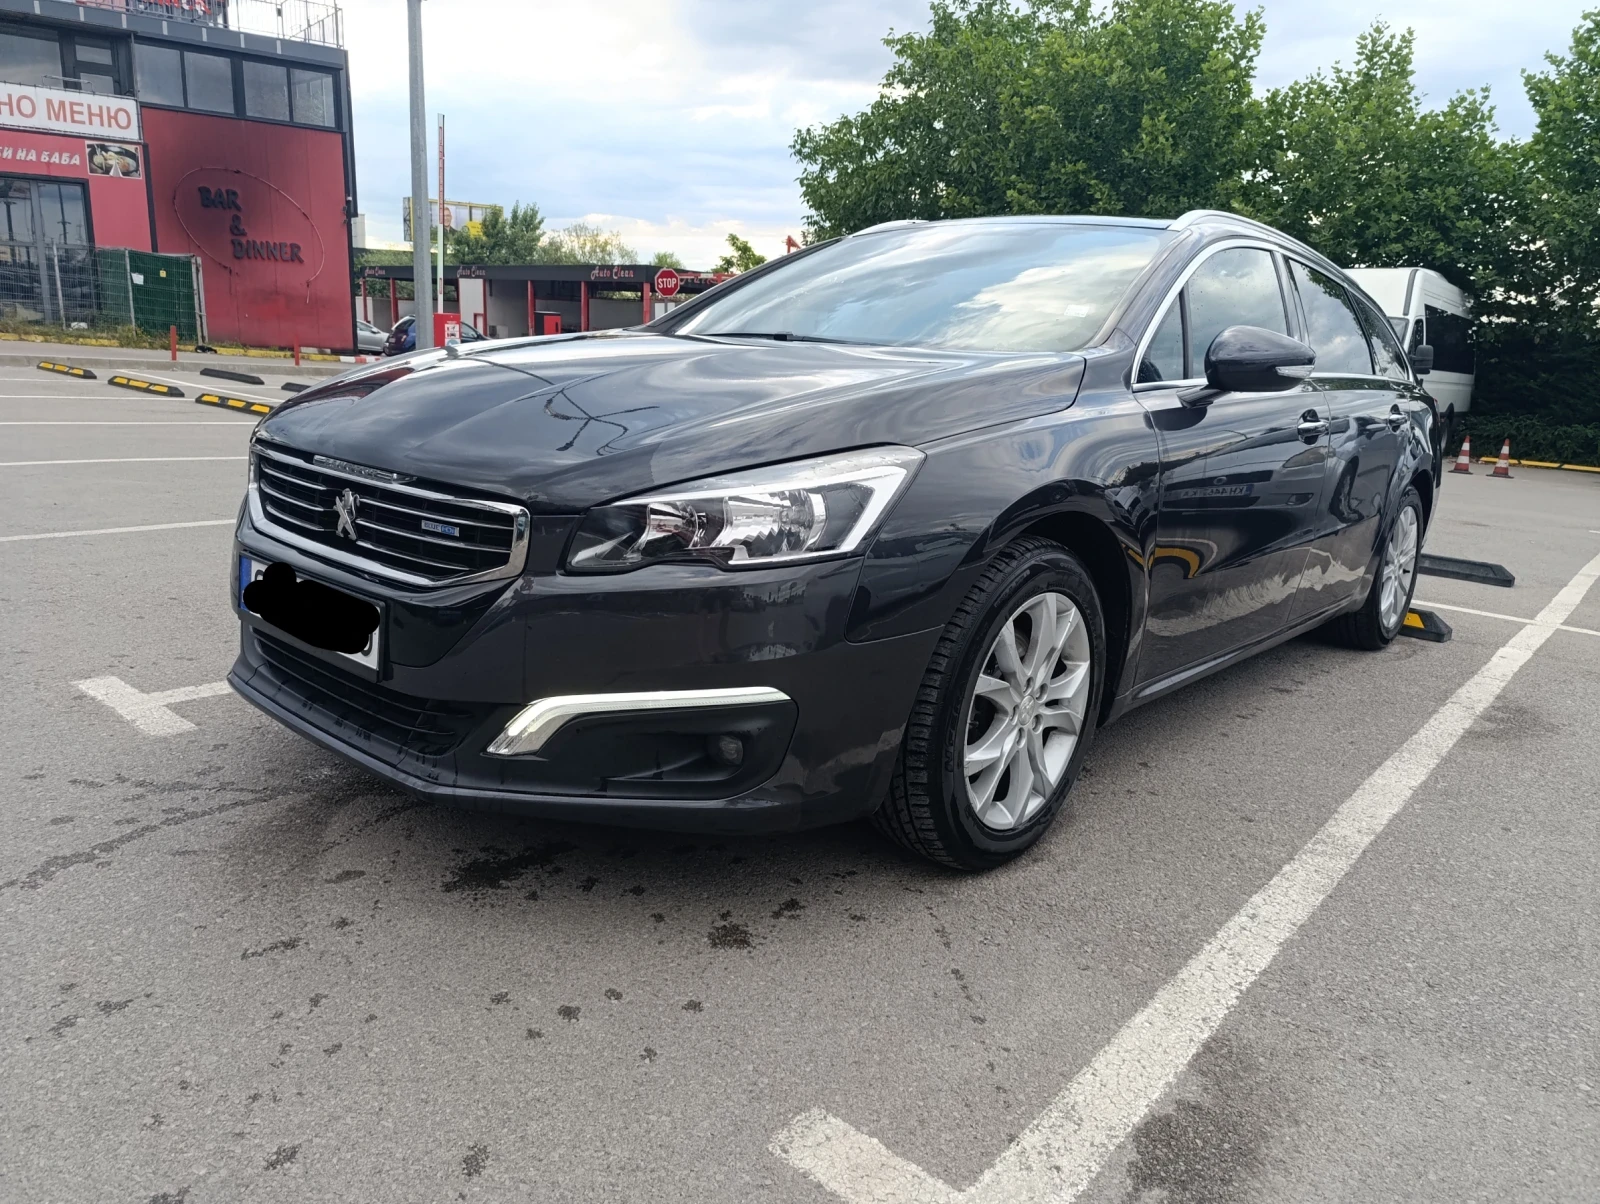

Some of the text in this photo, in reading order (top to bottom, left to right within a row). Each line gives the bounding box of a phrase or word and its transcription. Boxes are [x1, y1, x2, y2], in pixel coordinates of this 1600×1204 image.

[45, 98, 132, 130] МЕНЮ
[16, 148, 37, 162] НА
[40, 150, 80, 166] БАБА
[198, 186, 242, 212] BAR
[229, 214, 247, 236] &
[231, 239, 304, 263] DINNER
[457, 265, 486, 278] Auto Clean
[590, 266, 634, 280] Auto Clean
[658, 278, 677, 289] STOP
